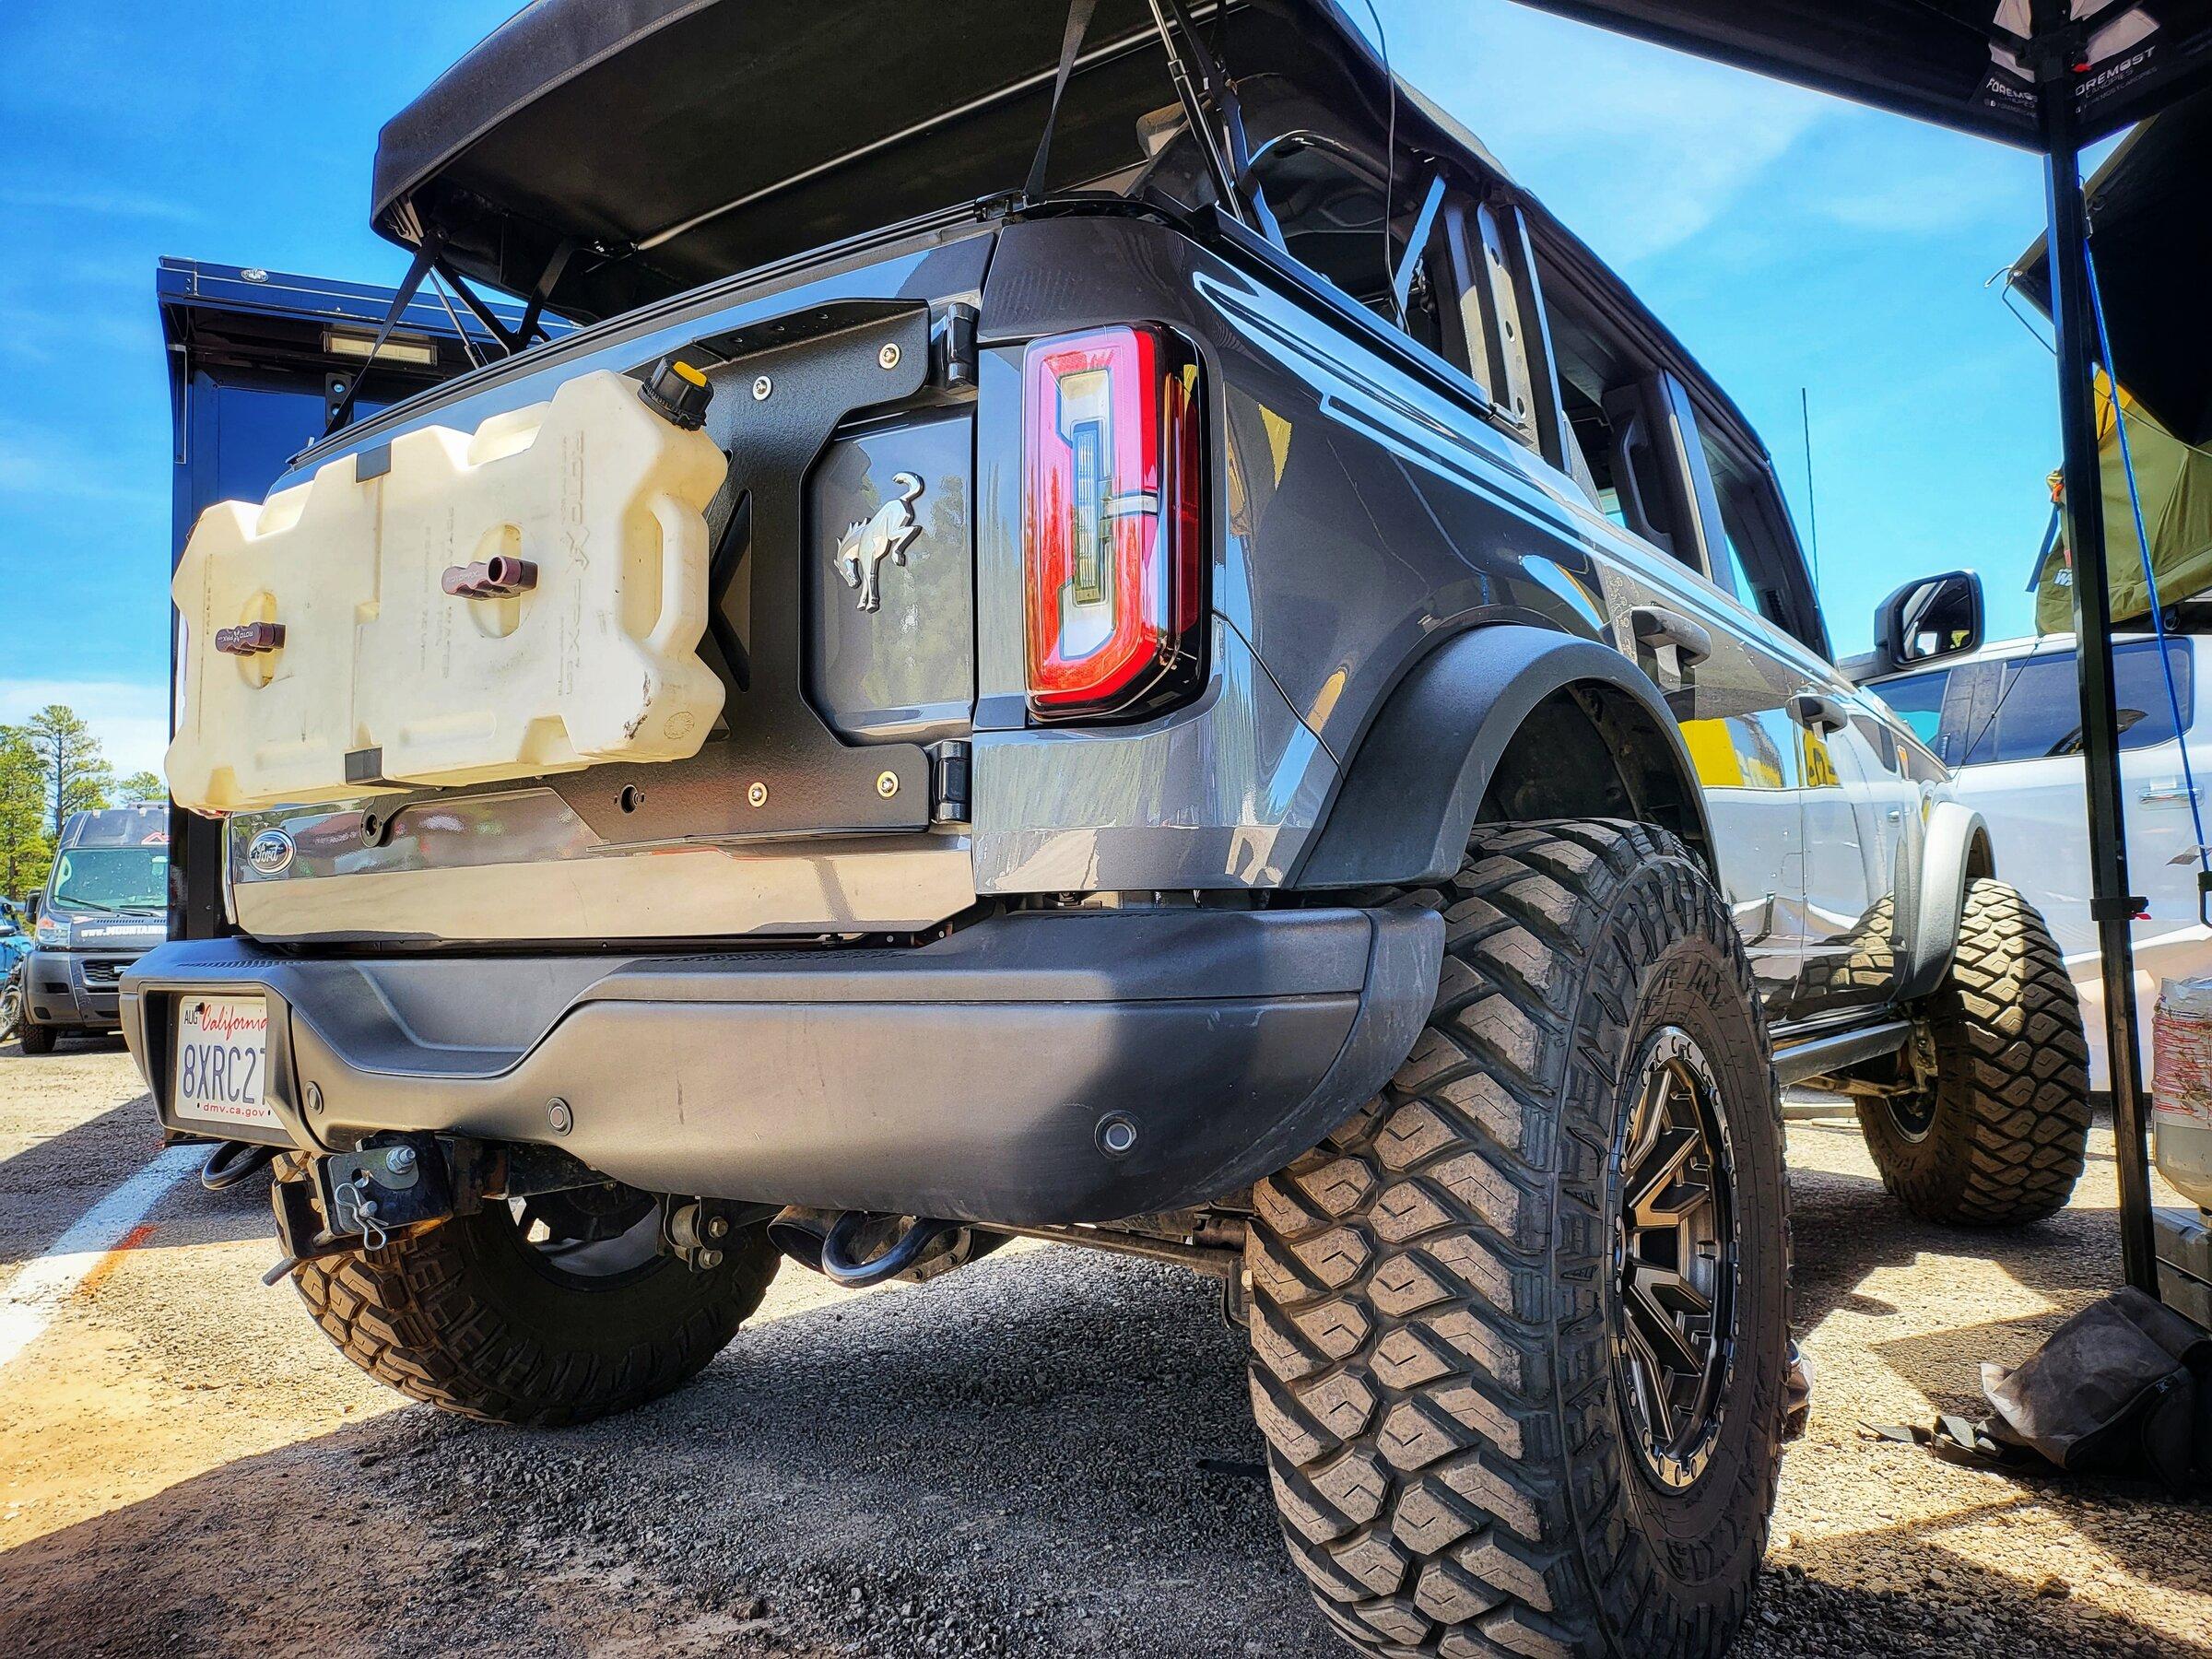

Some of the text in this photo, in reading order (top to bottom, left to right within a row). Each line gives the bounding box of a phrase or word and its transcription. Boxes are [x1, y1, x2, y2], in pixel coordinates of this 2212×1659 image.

[2075, 45, 2156, 97] OREMOST
[253, 841, 278, 864] Ford
[184, 1009, 198, 1025] AUG
[202, 1004, 269, 1041] California
[204, 1103, 265, 1118] dmv.ca.gov
